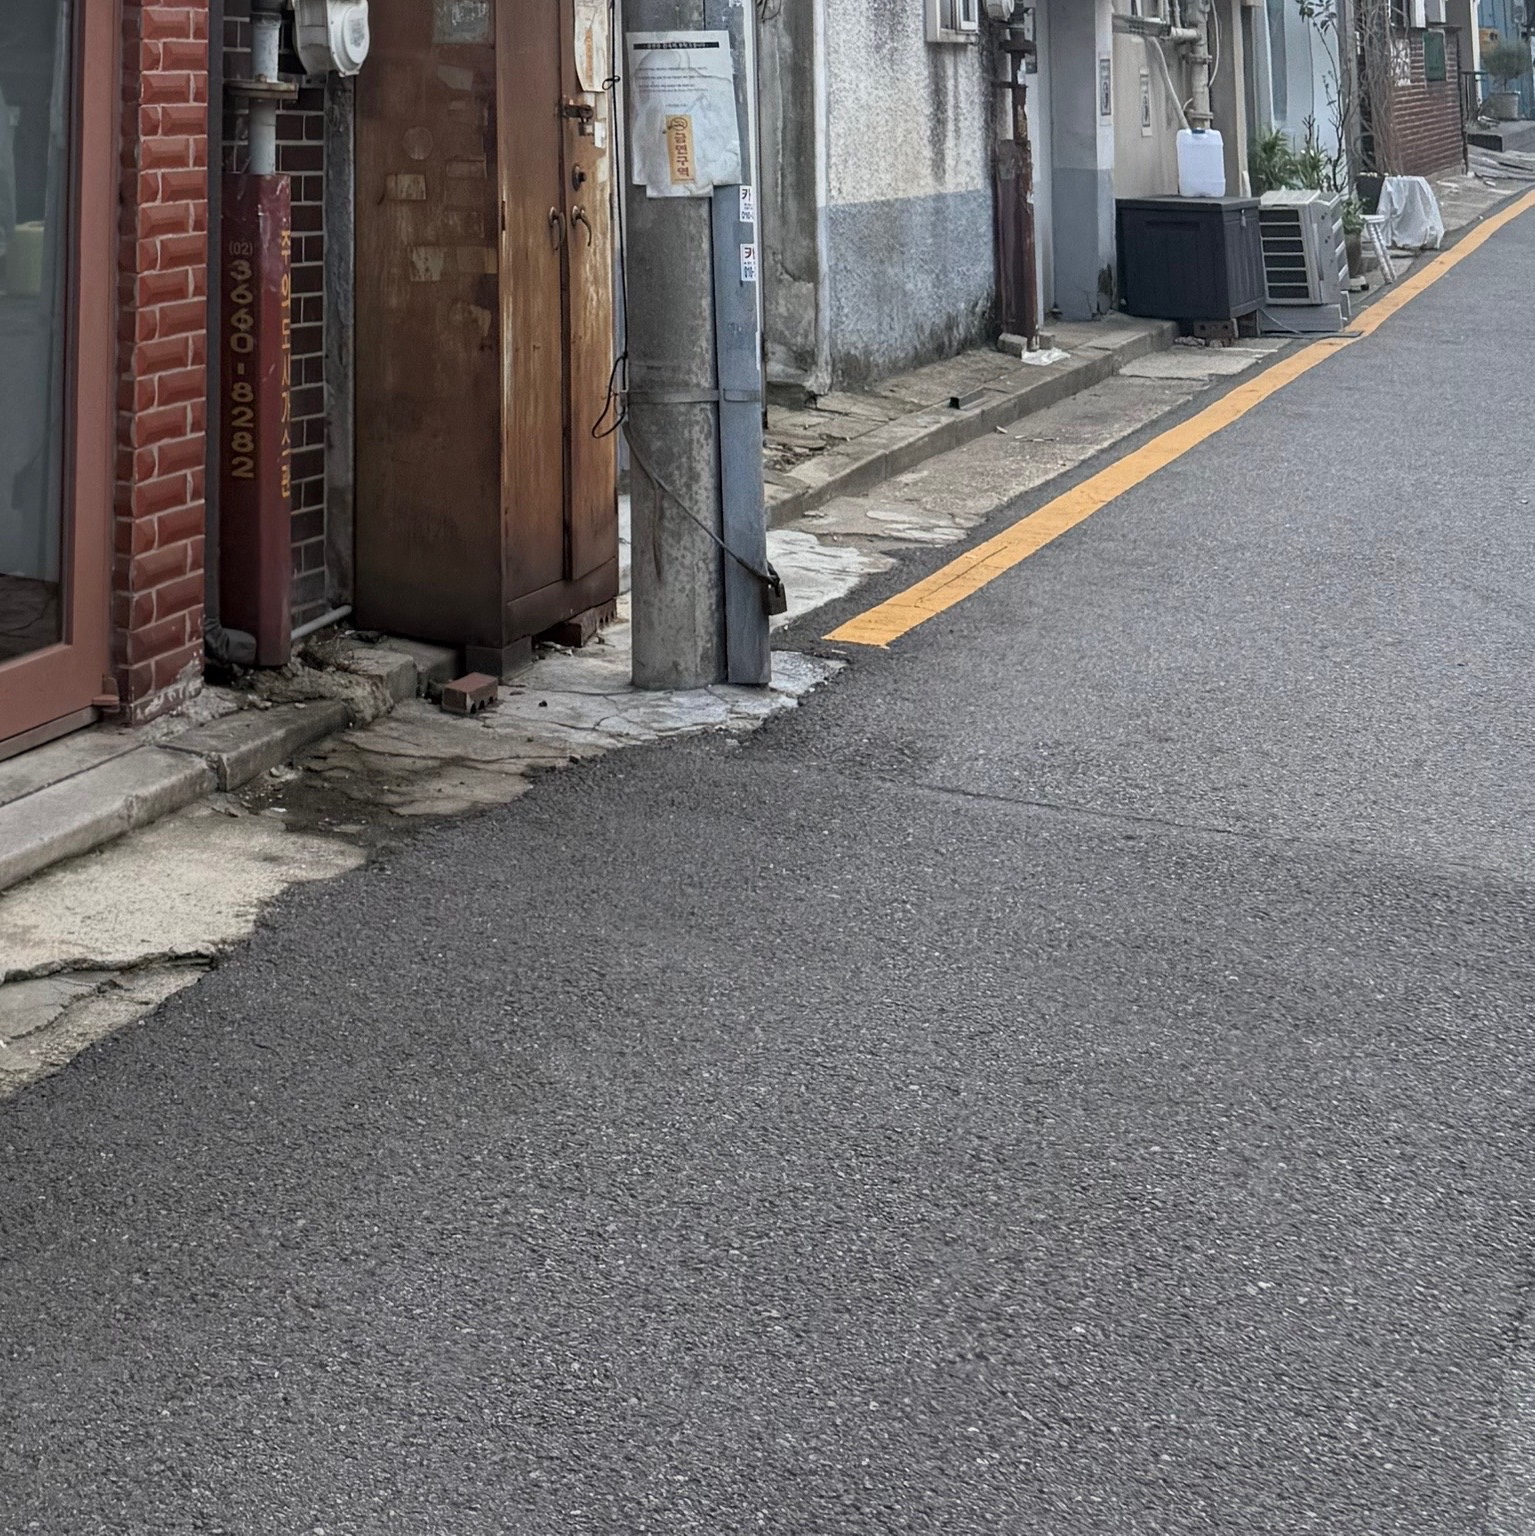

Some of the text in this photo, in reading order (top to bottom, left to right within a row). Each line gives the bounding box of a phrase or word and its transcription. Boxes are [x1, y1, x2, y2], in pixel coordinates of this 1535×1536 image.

[674, 132, 689, 177] 금연구역
[229, 241, 253, 255] (02)
[230, 259, 255, 478] 3660-8282
